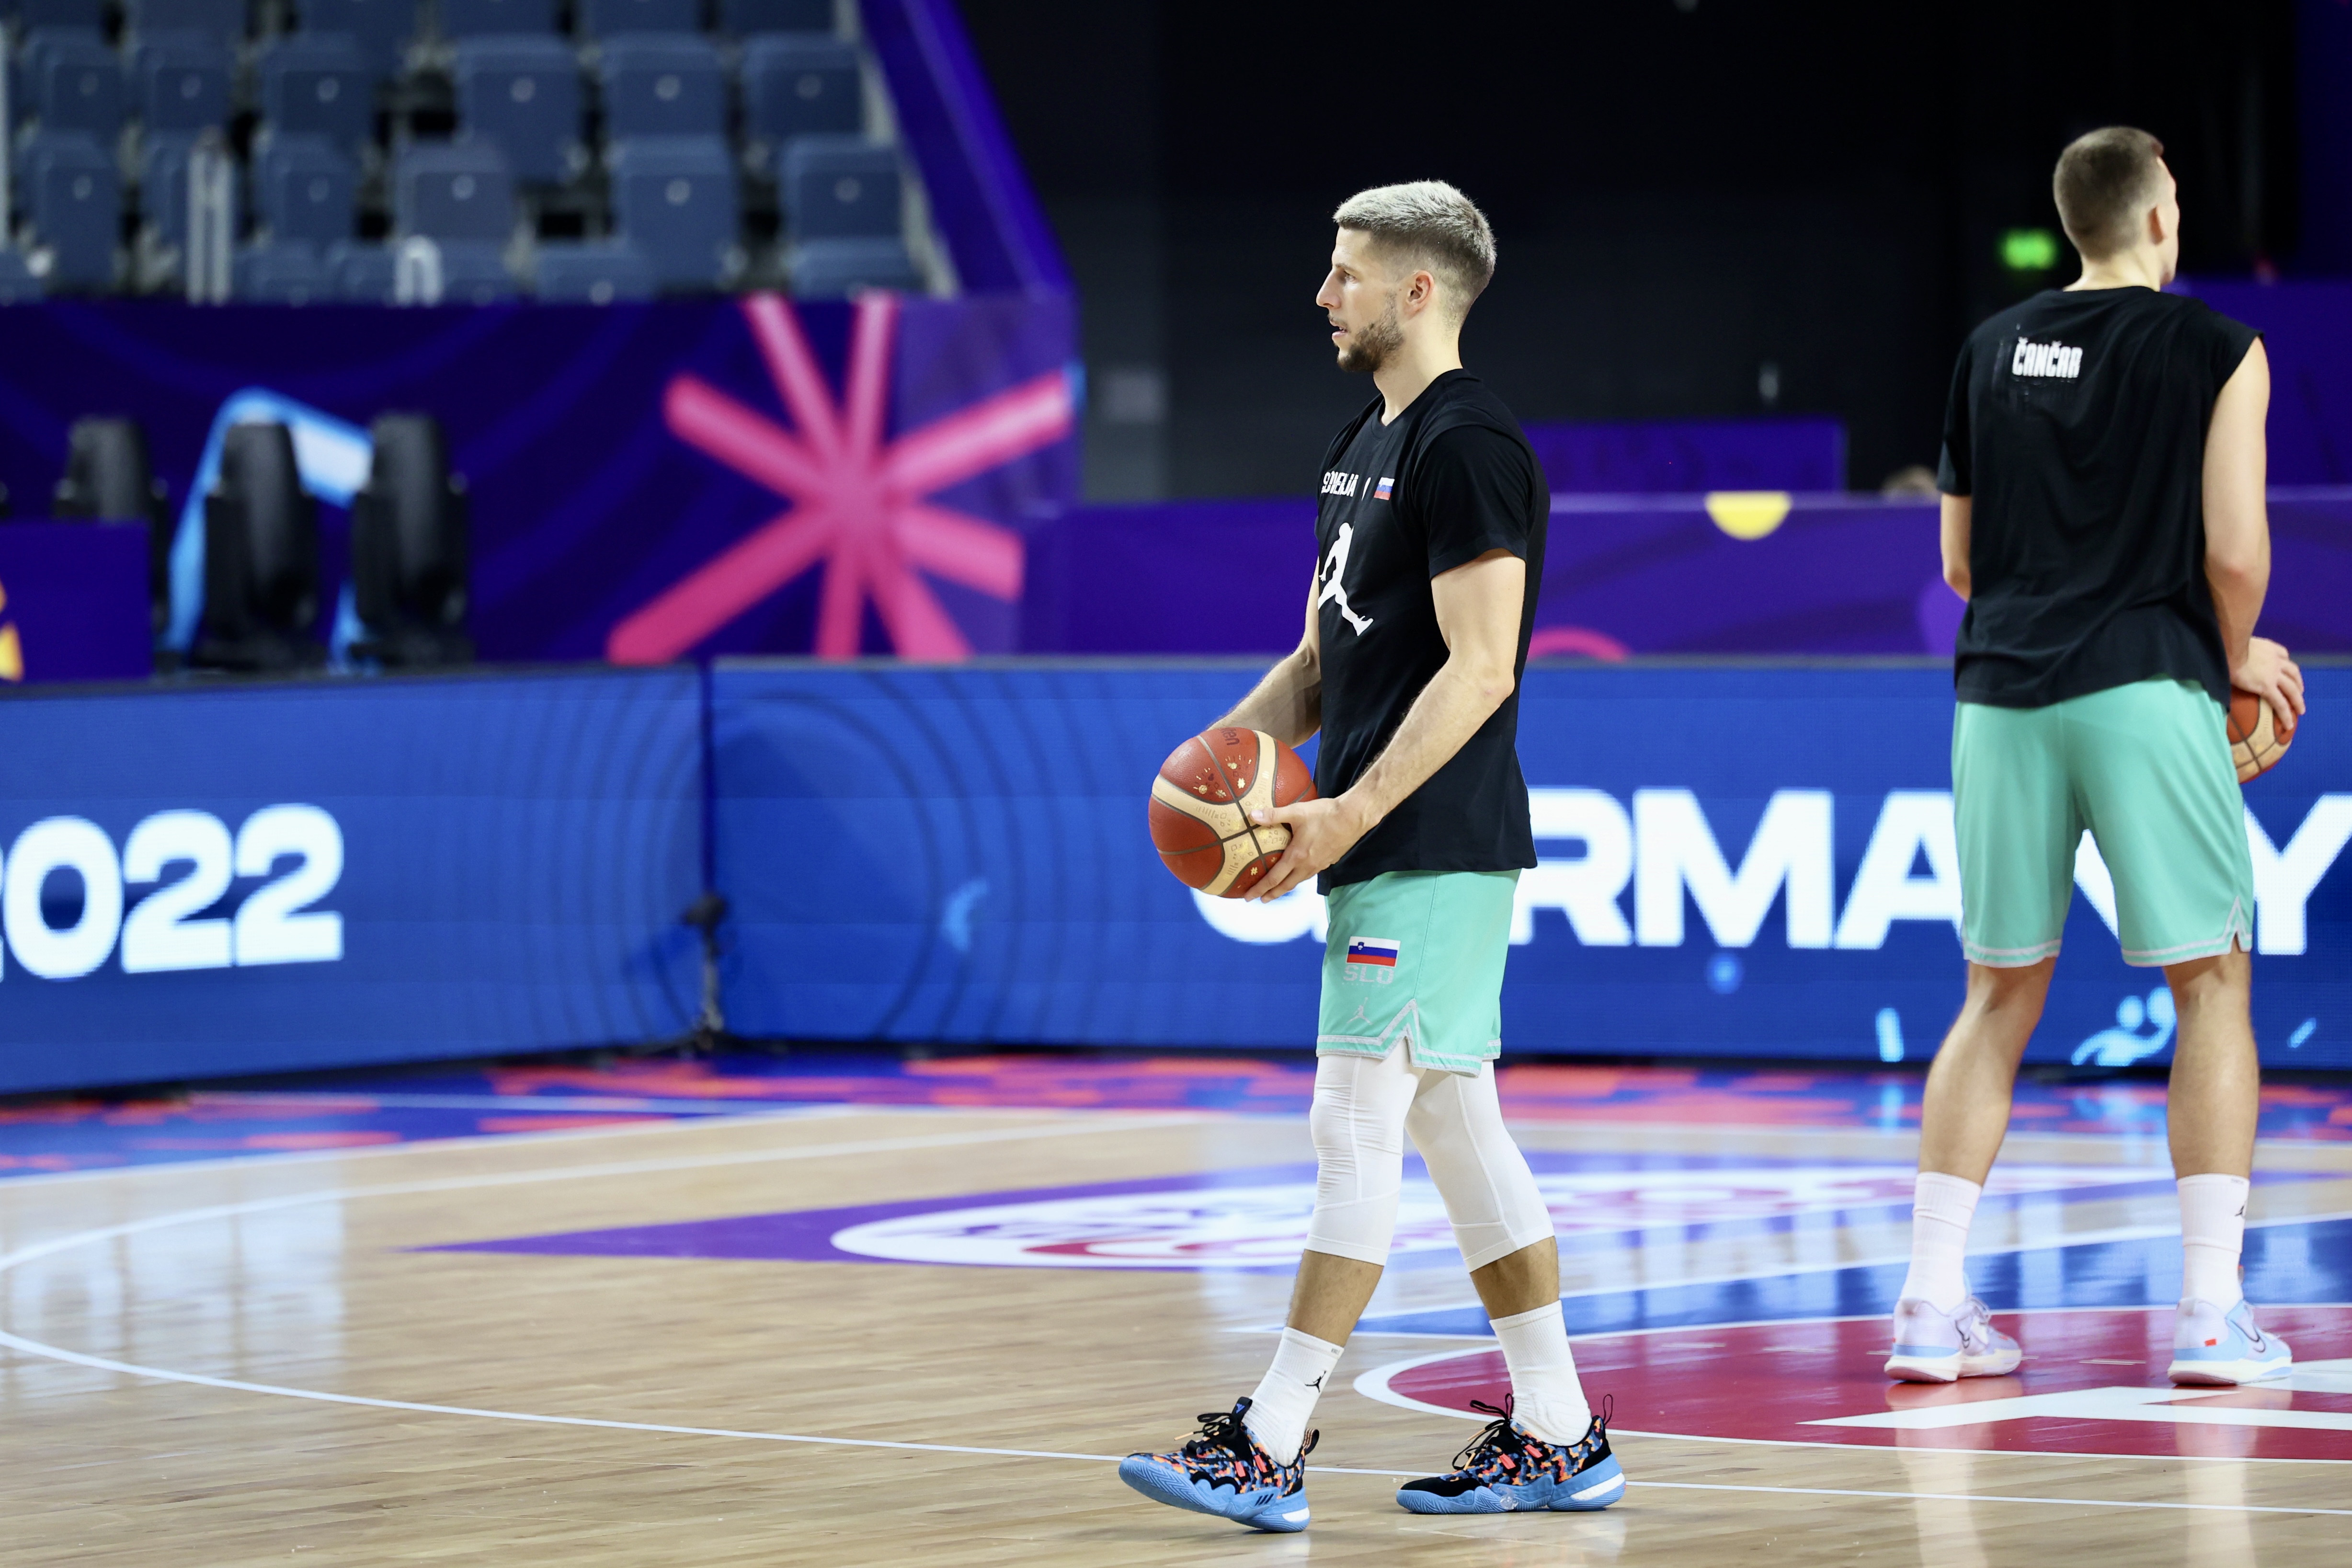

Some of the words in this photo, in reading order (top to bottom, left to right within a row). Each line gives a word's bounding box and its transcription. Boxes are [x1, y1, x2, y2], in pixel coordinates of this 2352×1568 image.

[2012, 336, 2083, 378] ČANČAR
[0, 802, 344, 982] 022
[1343, 964, 1394, 984] SLO
